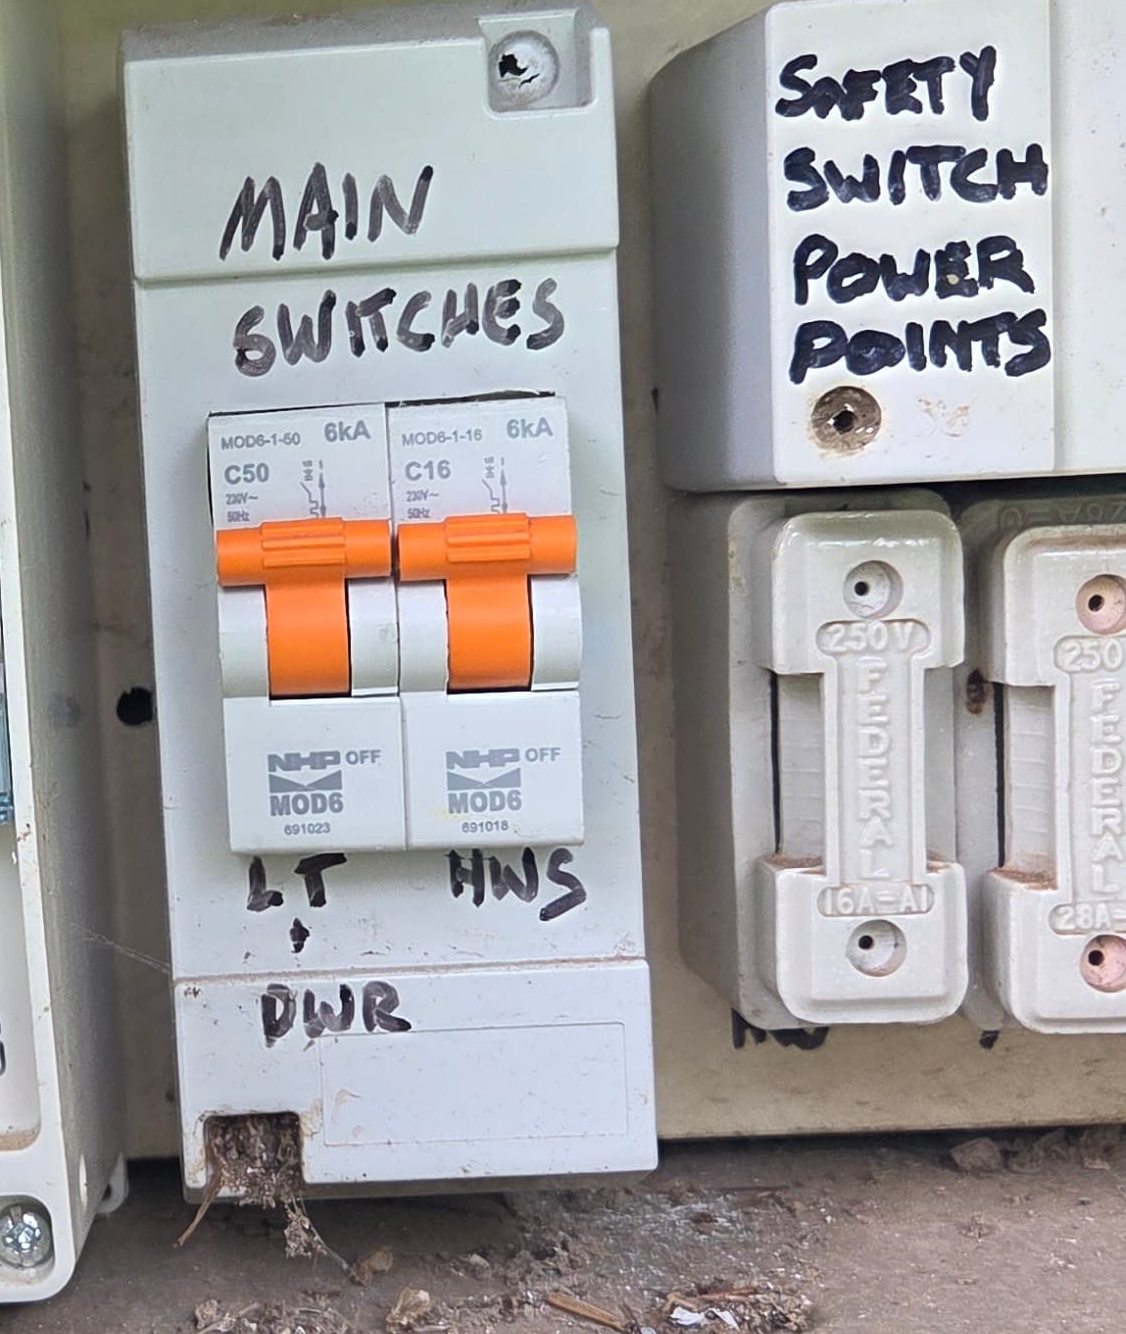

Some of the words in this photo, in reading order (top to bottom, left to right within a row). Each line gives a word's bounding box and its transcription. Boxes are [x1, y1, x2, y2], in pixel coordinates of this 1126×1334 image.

[783, 143, 1049, 212] SWITCH
[219, 162, 434, 261] MAIN
[793, 233, 1035, 306] POWER
[234, 278, 566, 377] SWITCHES
[789, 308, 1052, 385] POINTS
[324, 420, 371, 443] 6kA
[402, 429, 483, 446] MOD6-1-16
[506, 417, 553, 439] 6kA
[224, 463, 270, 485] C50
[405, 459, 451, 481] C16
[267, 750, 341, 773] NHP
[345, 749, 382, 766] OFF
[446, 748, 521, 770] NHP
[525, 746, 562, 763] OFF
[855, 655, 894, 880] FEDERAL
[1090, 677, 1122, 894] FEDERAL
[269, 792, 345, 817] MOD6
[447, 790, 523, 815] MOD6
[284, 823, 331, 836] 691023
[462, 820, 509, 833] 691018
[446, 846, 587, 922] HWS
